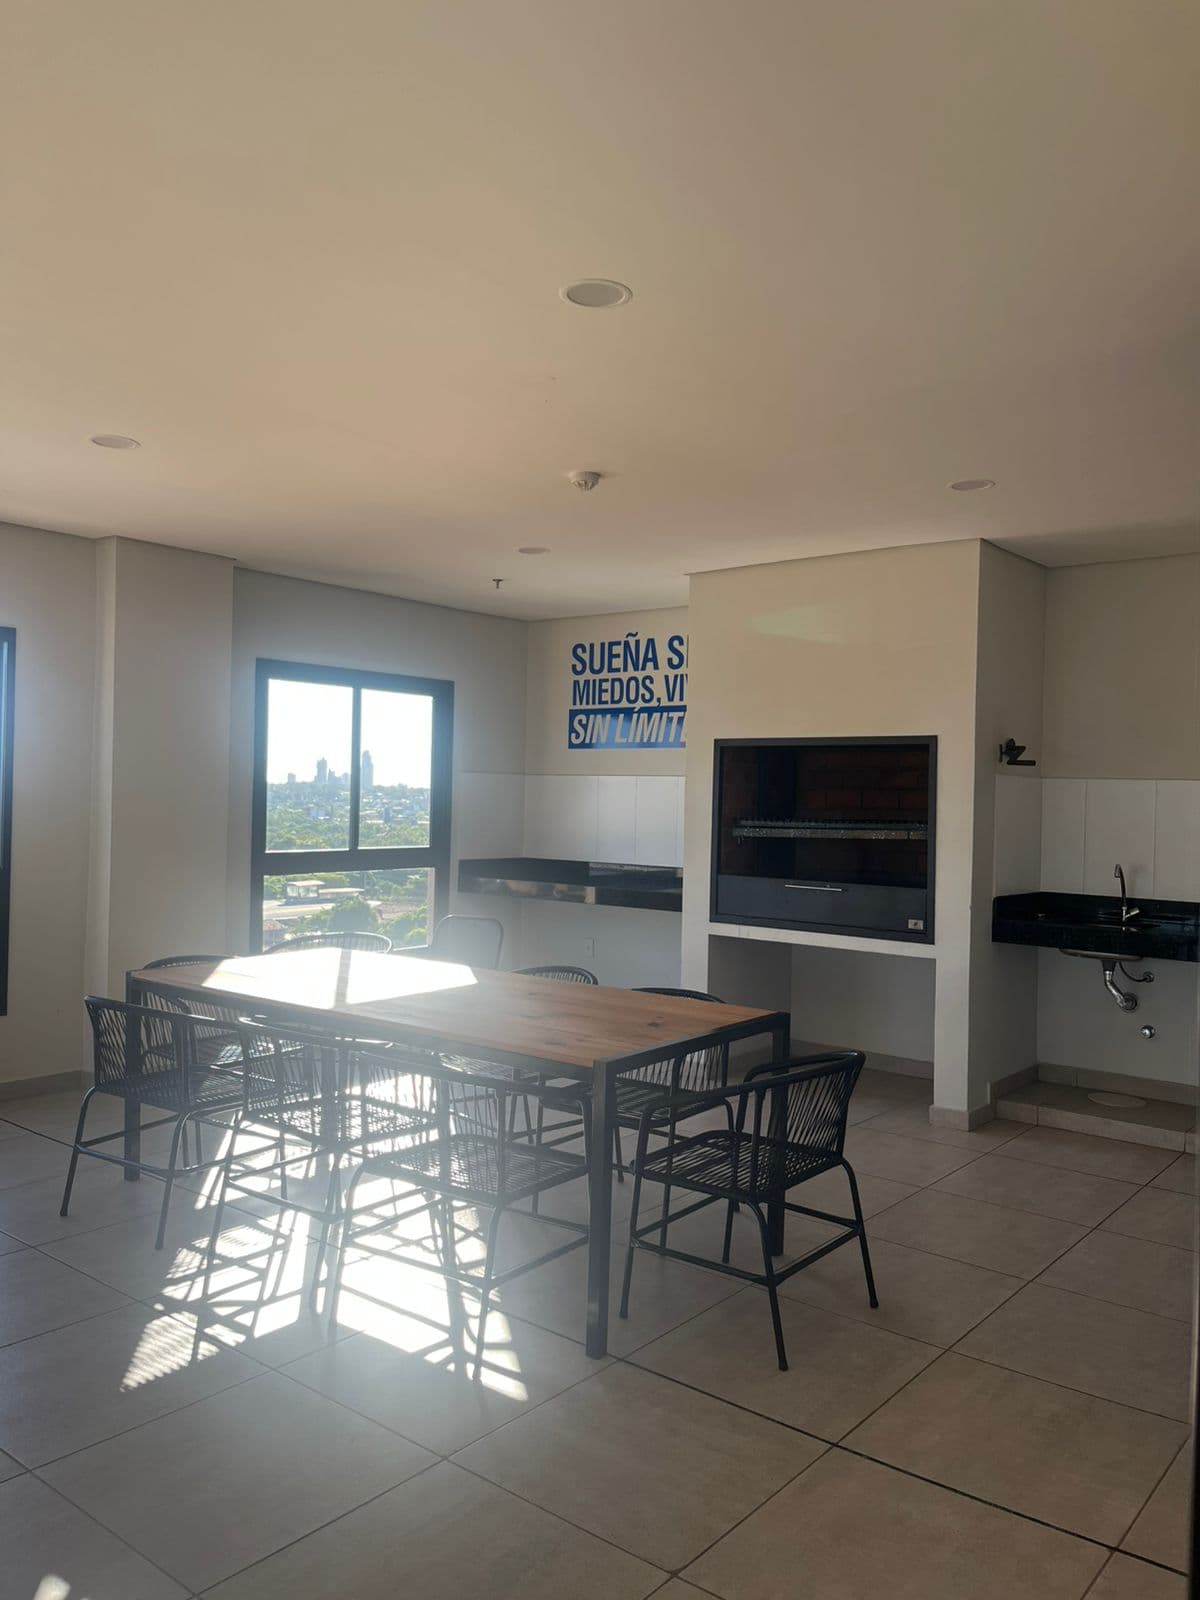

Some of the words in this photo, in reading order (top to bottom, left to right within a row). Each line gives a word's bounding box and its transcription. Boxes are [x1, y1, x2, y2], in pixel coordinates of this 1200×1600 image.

[571, 632, 659, 676] SUEÑA
[572, 675, 661, 708] MIEDOS,
[664, 673, 688, 703] VI
[571, 714, 610, 745] SIN
